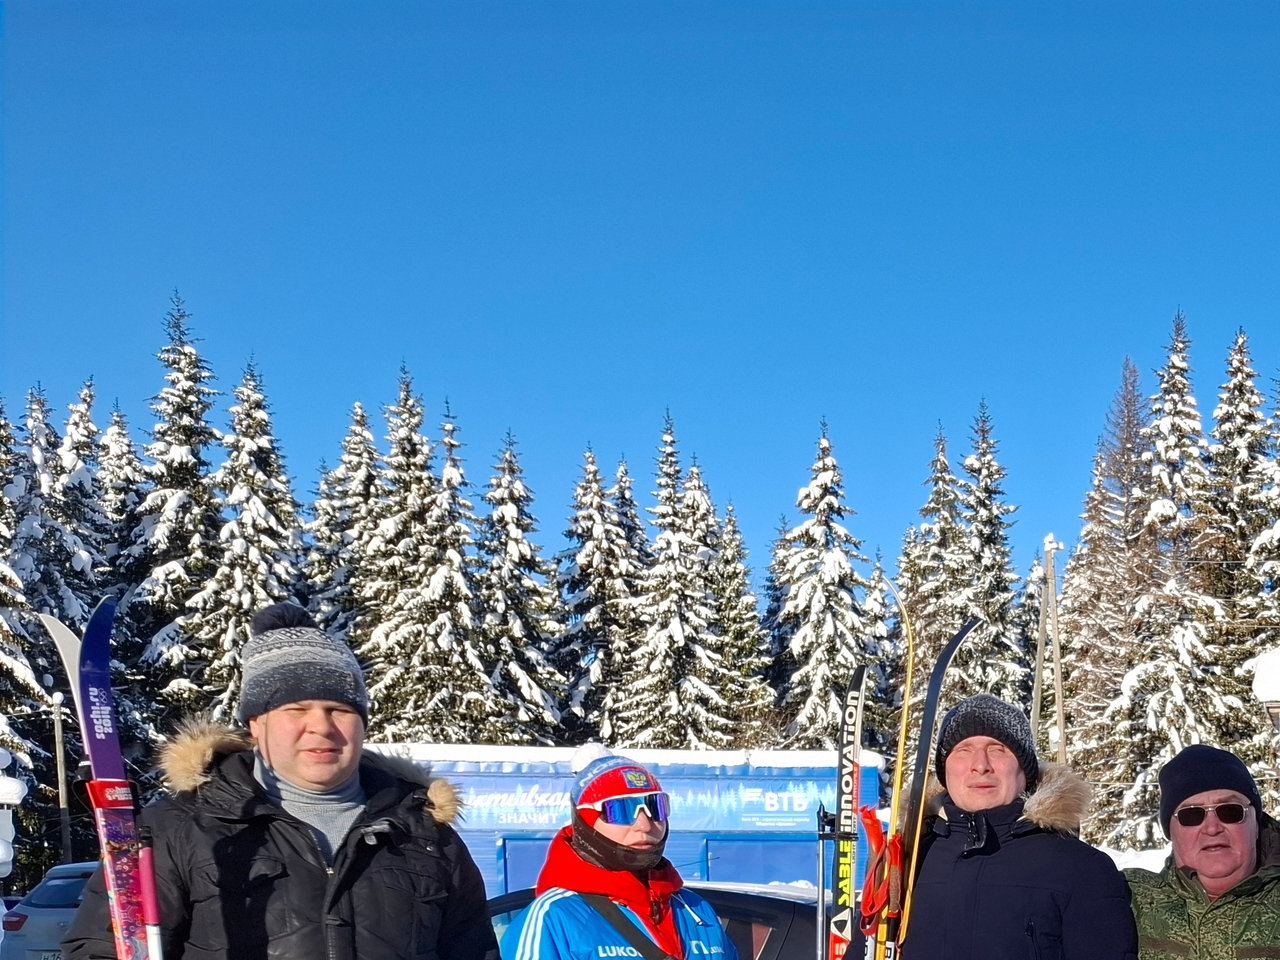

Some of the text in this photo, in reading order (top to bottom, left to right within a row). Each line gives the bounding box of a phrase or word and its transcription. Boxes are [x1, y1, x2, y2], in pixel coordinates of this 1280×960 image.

[89, 687, 105, 739] sochi.ru
[764, 791, 808, 812] ВТБ
[498, 812, 558, 824] ЗНАЧИТ
[838, 840, 851, 907] SABLE
[598, 945, 644, 957] LUKO
